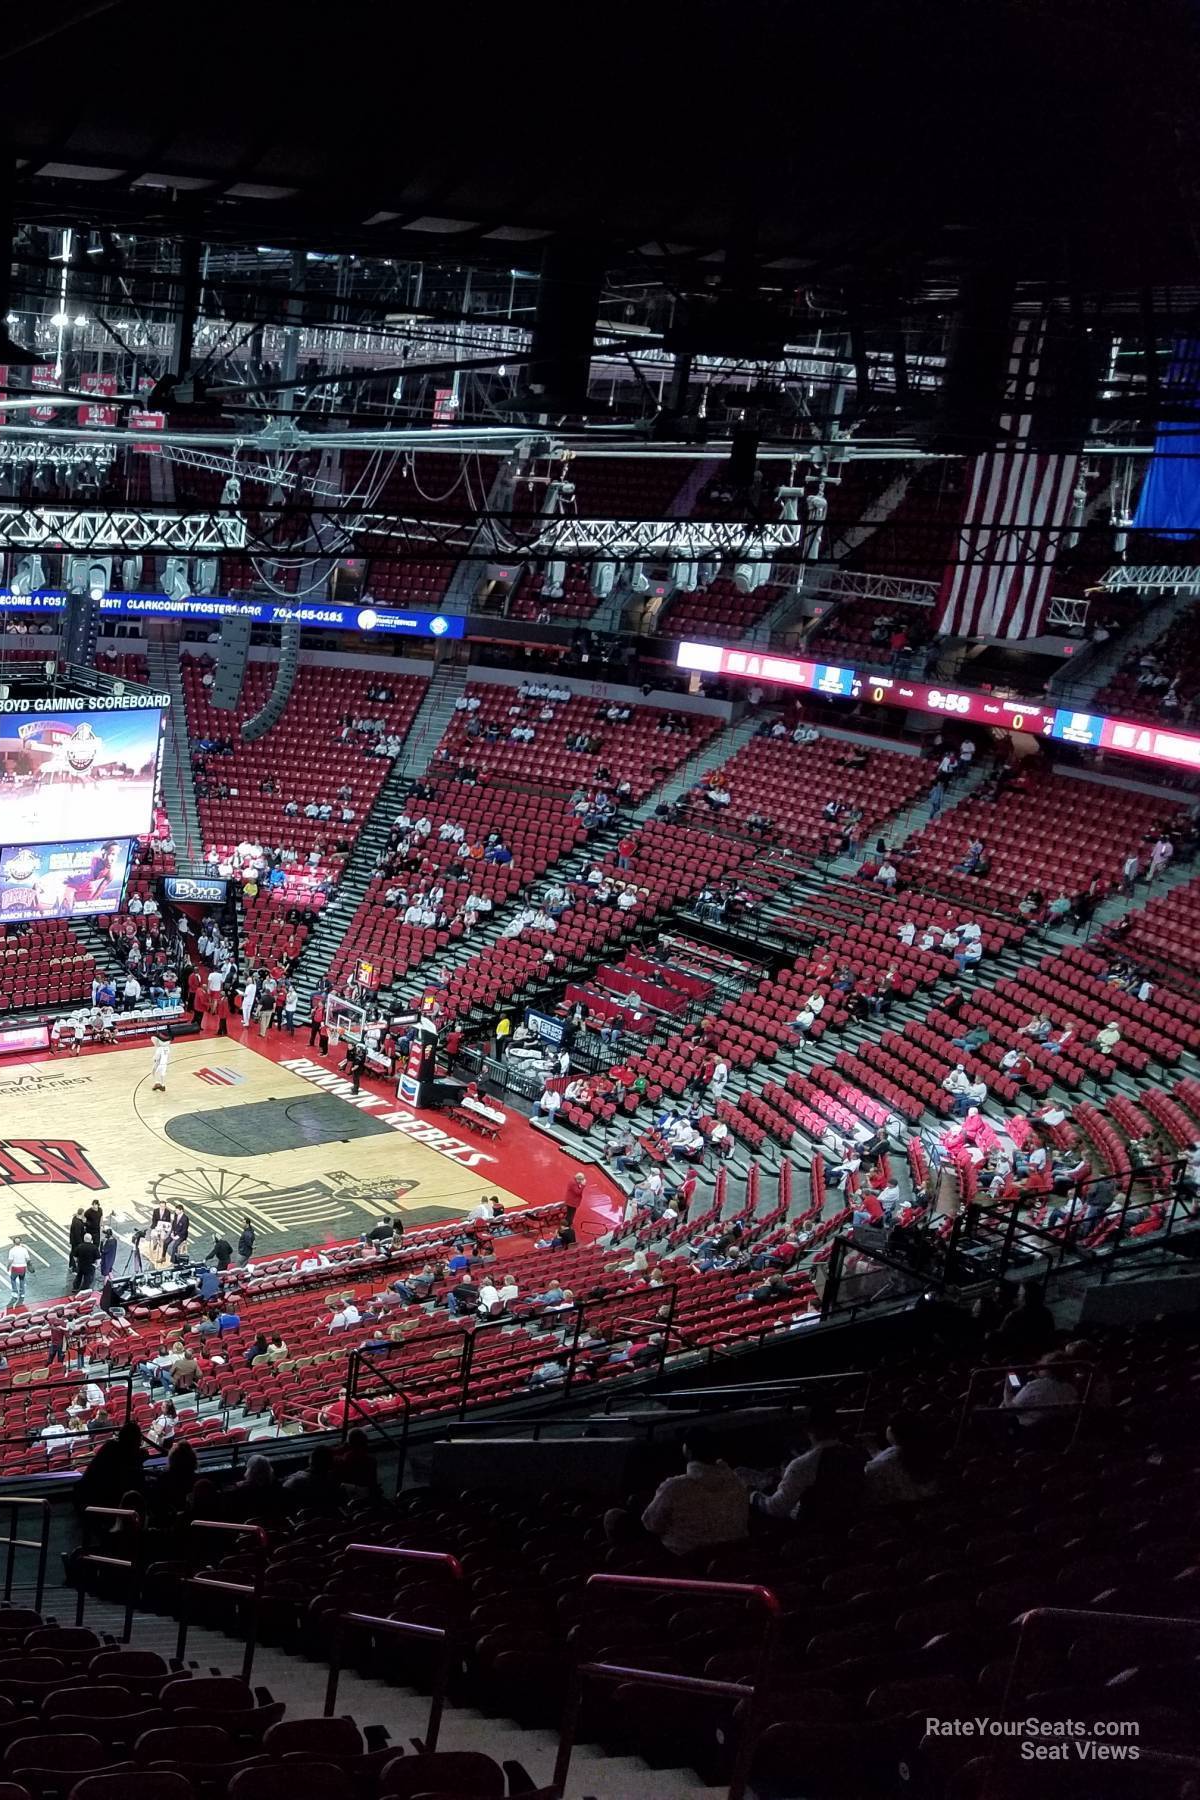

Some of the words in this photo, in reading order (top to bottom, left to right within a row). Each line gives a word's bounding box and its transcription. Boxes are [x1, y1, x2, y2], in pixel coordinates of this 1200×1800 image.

[33, 597, 41, 606] A
[19, 637, 35, 648] 119
[590, 684, 608, 696] 121
[34, 698, 85, 712] GAMING
[88, 694, 171, 710] SCOREBOARD
[873, 687, 883, 702] 0
[1012, 714, 1023, 730] 0
[551, 1025, 562, 1035] SPO
[49, 1076, 94, 1088] FIRST
[278, 1058, 394, 1108] RUNNIN'
[375, 1111, 499, 1167] REBELS
